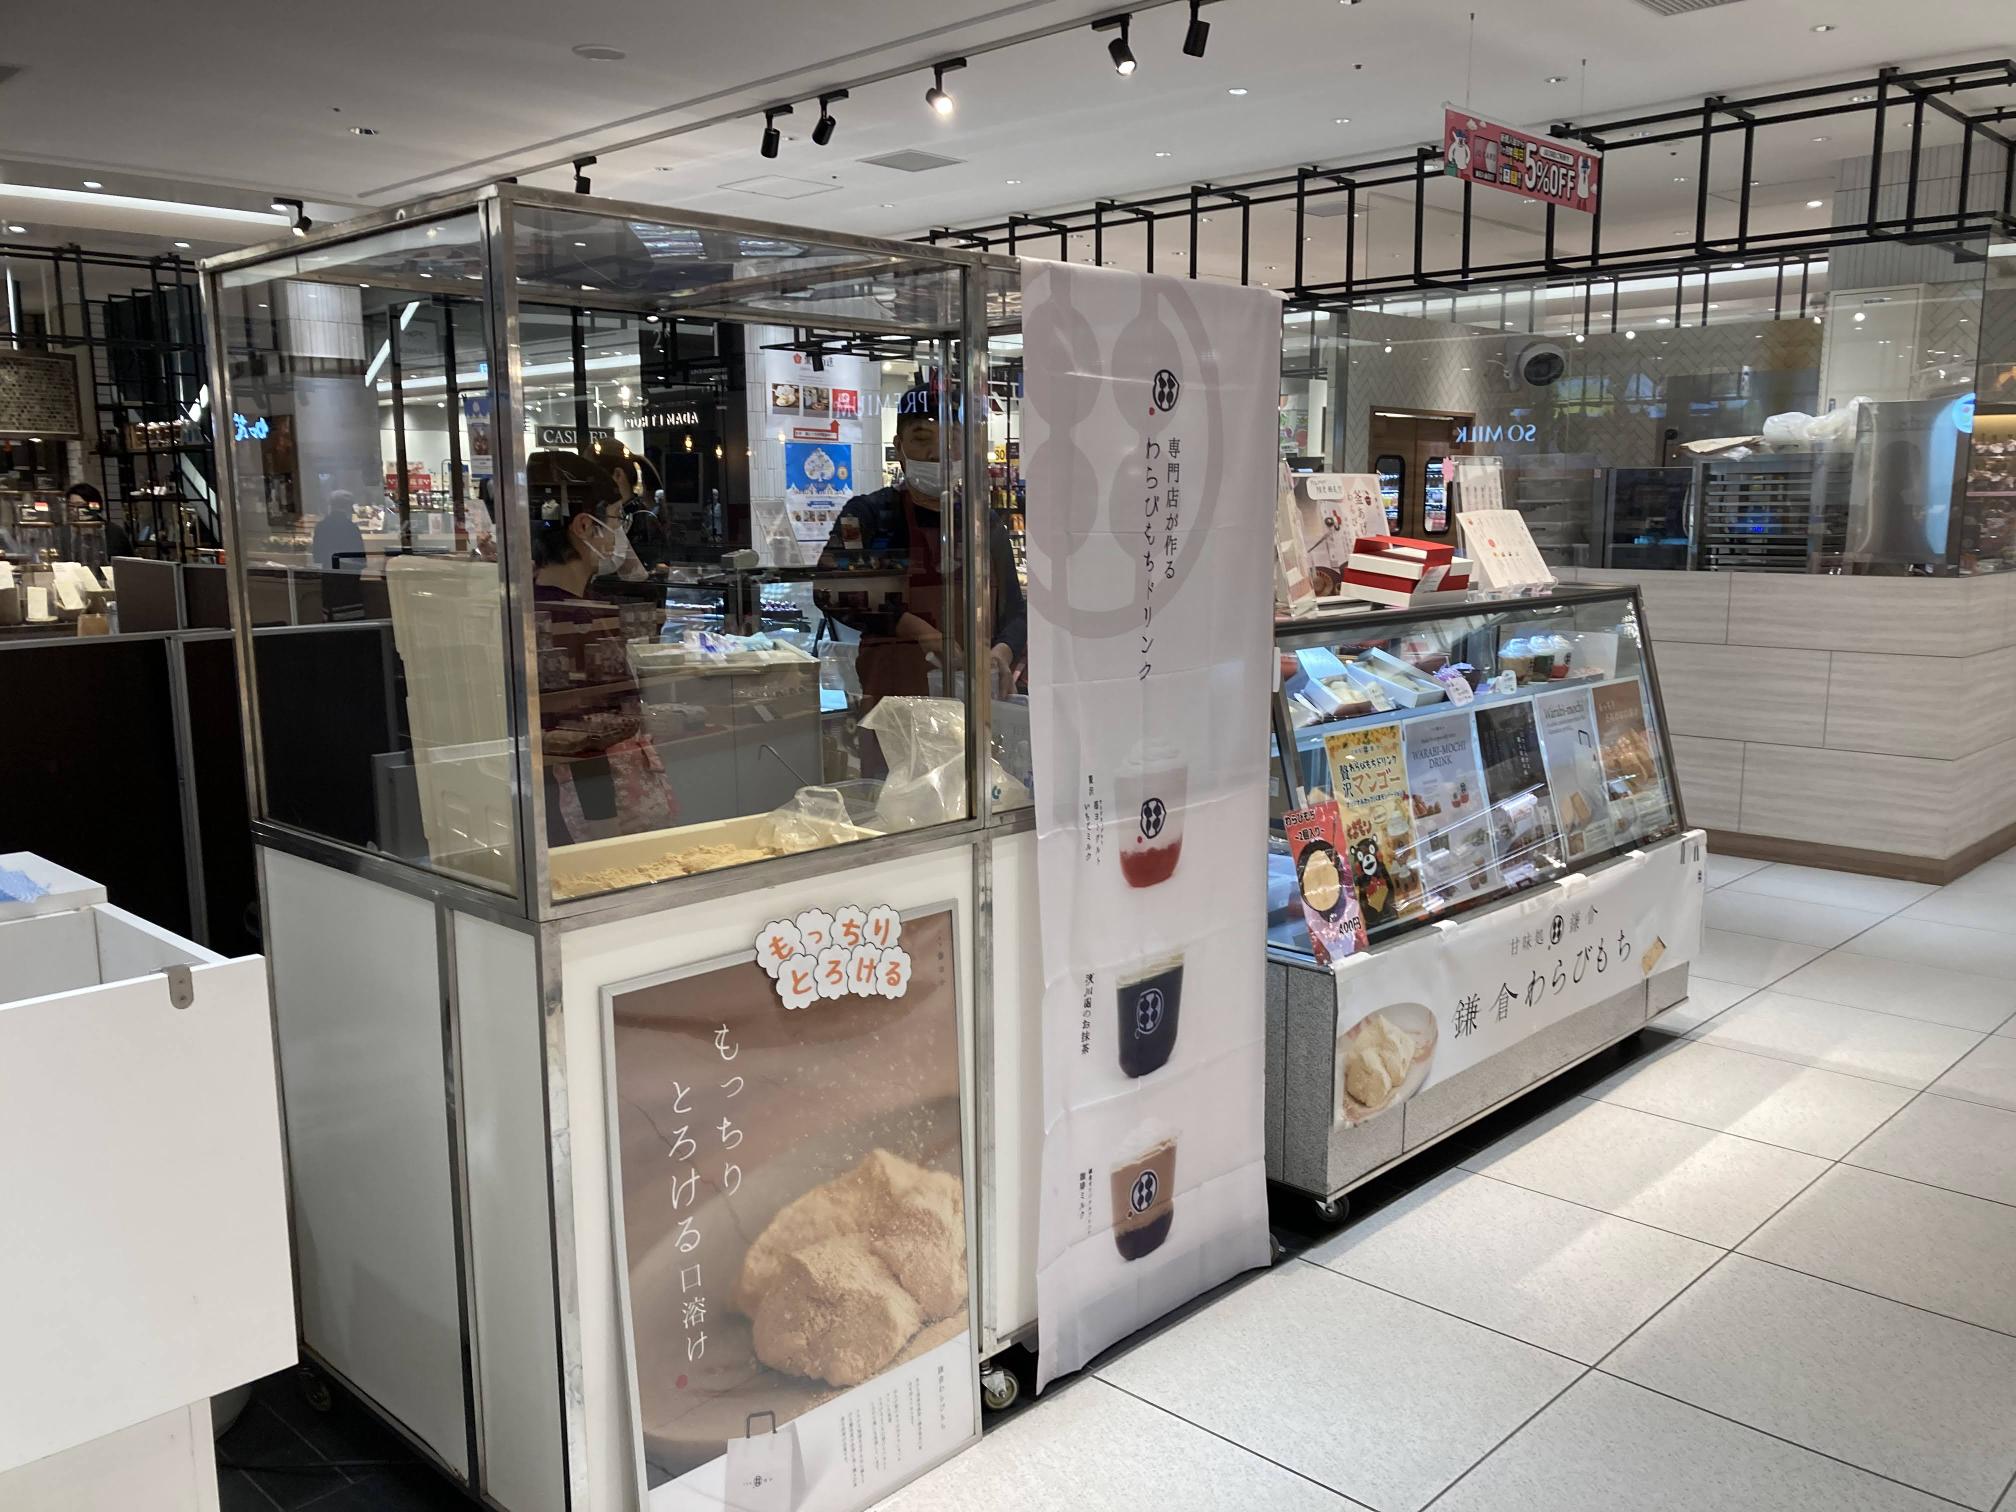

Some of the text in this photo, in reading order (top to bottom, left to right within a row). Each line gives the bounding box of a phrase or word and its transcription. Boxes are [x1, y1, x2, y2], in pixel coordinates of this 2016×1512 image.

[1524, 142, 1577, 201] 5%OFF
[1138, 436, 1161, 681] わらびもちドリンク
[1164, 436, 1181, 579] 専門店が作る
[1351, 767, 1401, 795] マンゴー
[768, 917, 890, 961] もっちり
[791, 957, 901, 995] とろける
[1451, 929, 1632, 1040] 鎌倉わらびもち
[714, 1023, 745, 1197] もっちり
[668, 1081, 708, 1362] とろける口溶け
